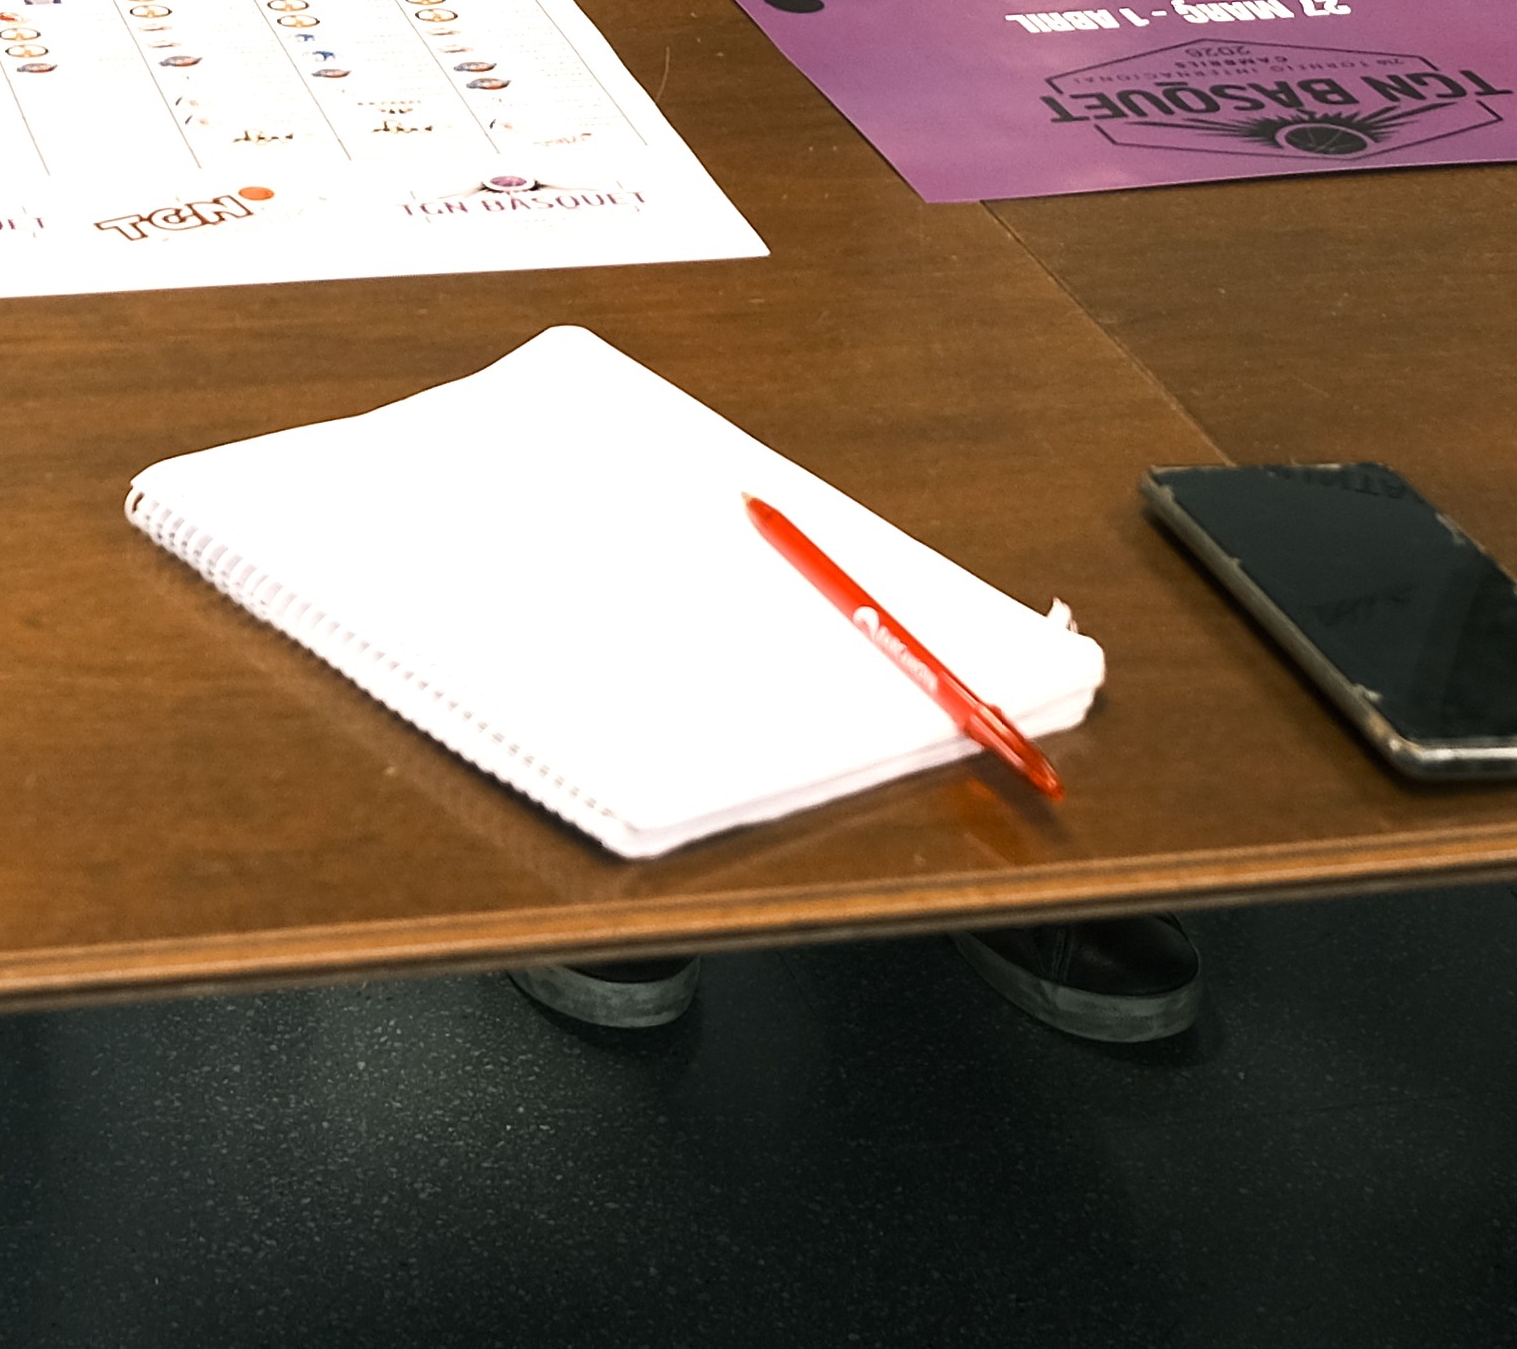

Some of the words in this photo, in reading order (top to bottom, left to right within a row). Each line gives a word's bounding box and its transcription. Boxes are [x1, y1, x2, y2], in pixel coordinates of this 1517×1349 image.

[1004, 9, 1119, 35] ABRIL
[1131, 5, 1150, 29] 1
[1184, 44, 1251, 59] 2026
[1173, 55, 1289, 70] CAMBRILS
[1267, 58, 1370, 75] TORNEIG
[1070, 65, 1260, 84] INTERNACIONAL
[1365, 69, 1513, 105] TGN
[94, 194, 256, 243] TGN
[398, 200, 469, 218] TGN
